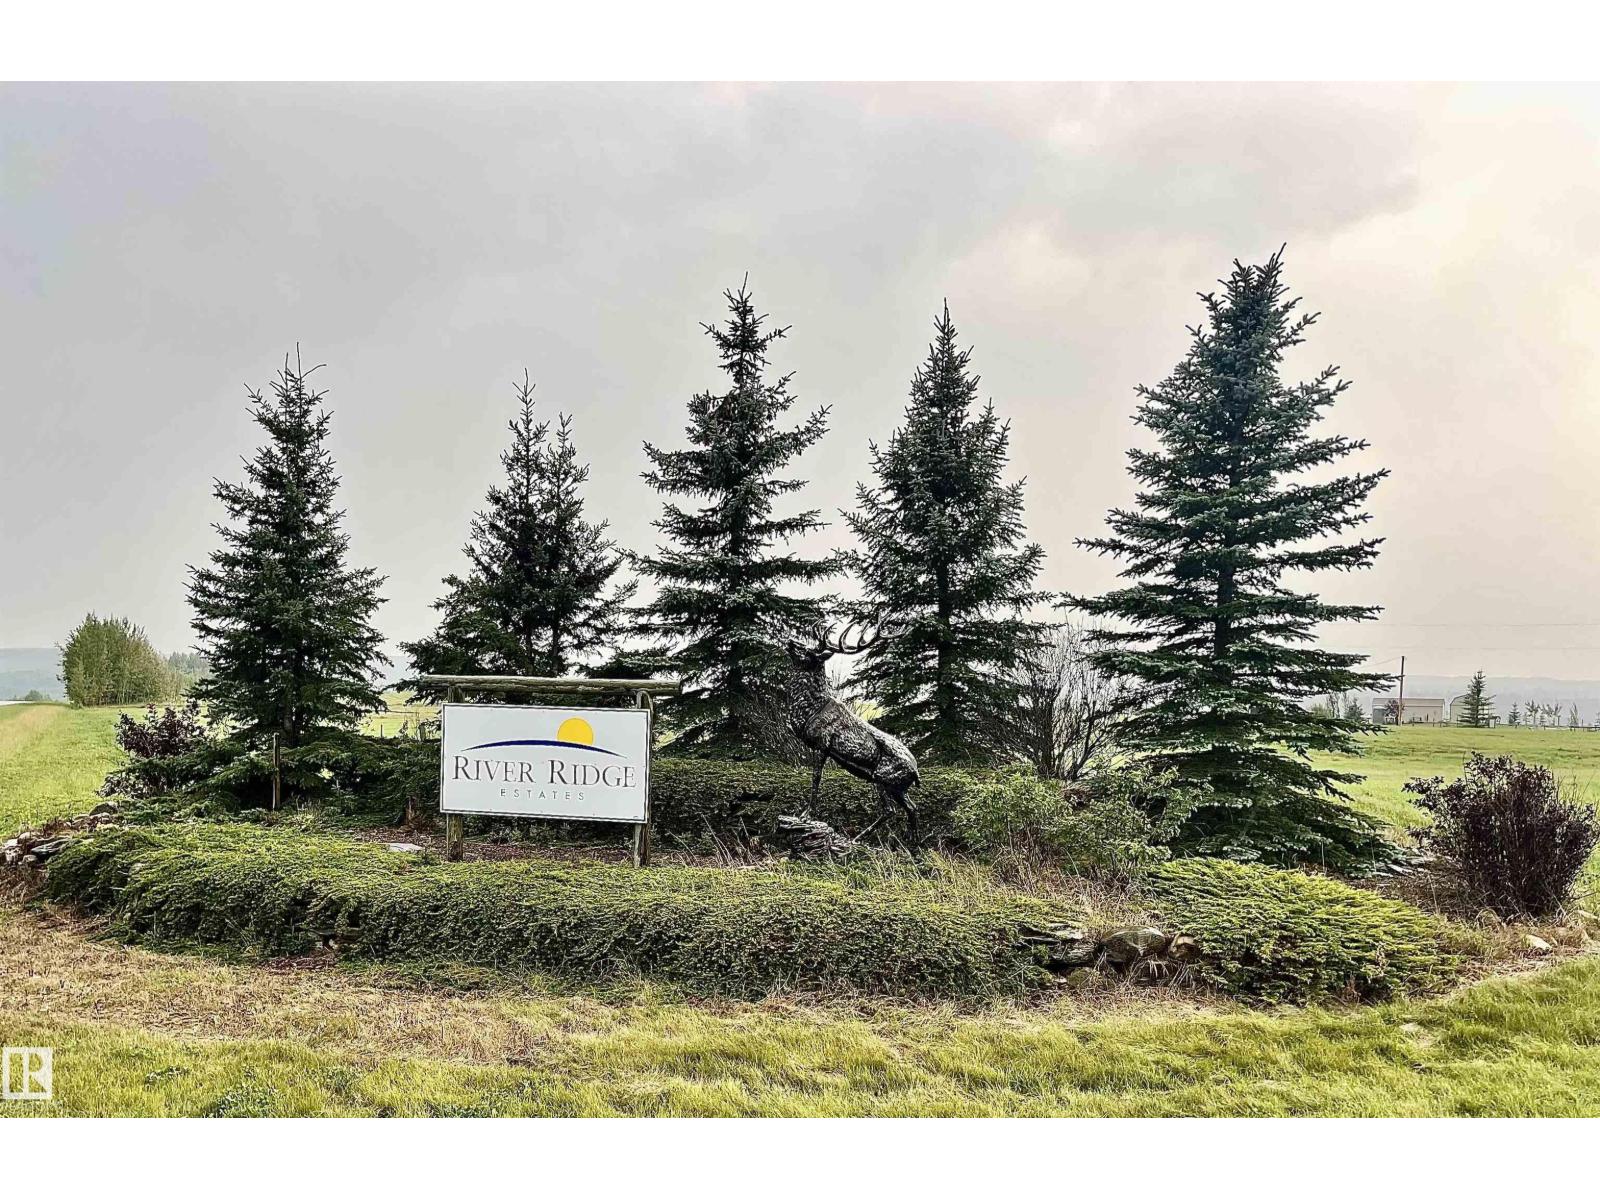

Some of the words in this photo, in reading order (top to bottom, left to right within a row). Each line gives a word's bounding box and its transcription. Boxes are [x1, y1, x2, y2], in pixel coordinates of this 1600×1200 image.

[452, 755, 535, 783] RIVER
[547, 759, 637, 788] RIDGE
[500, 788, 585, 801] ESTATES
